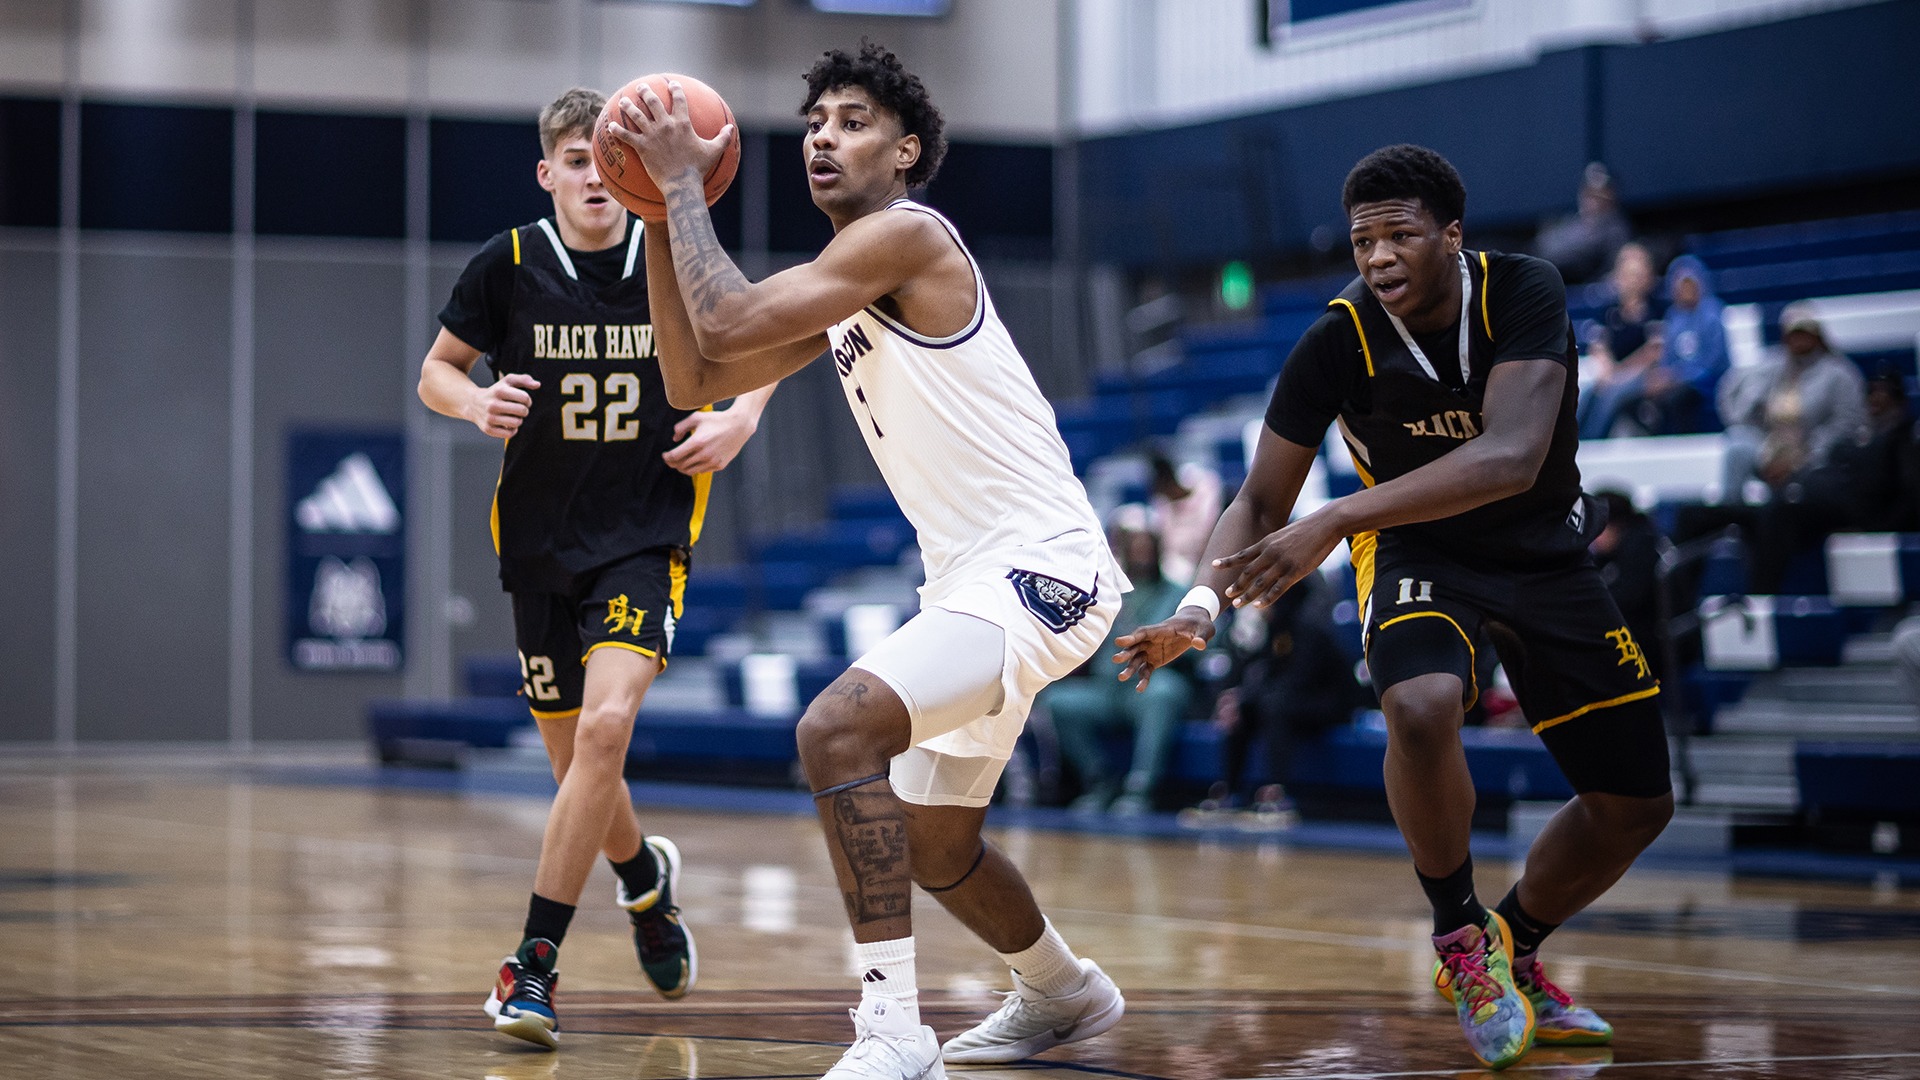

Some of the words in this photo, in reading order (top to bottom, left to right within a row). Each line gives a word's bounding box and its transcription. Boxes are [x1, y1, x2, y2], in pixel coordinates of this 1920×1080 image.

[533, 324, 598, 359] BLACK
[604, 324, 658, 359] HAW
[560, 372, 640, 443] 22
